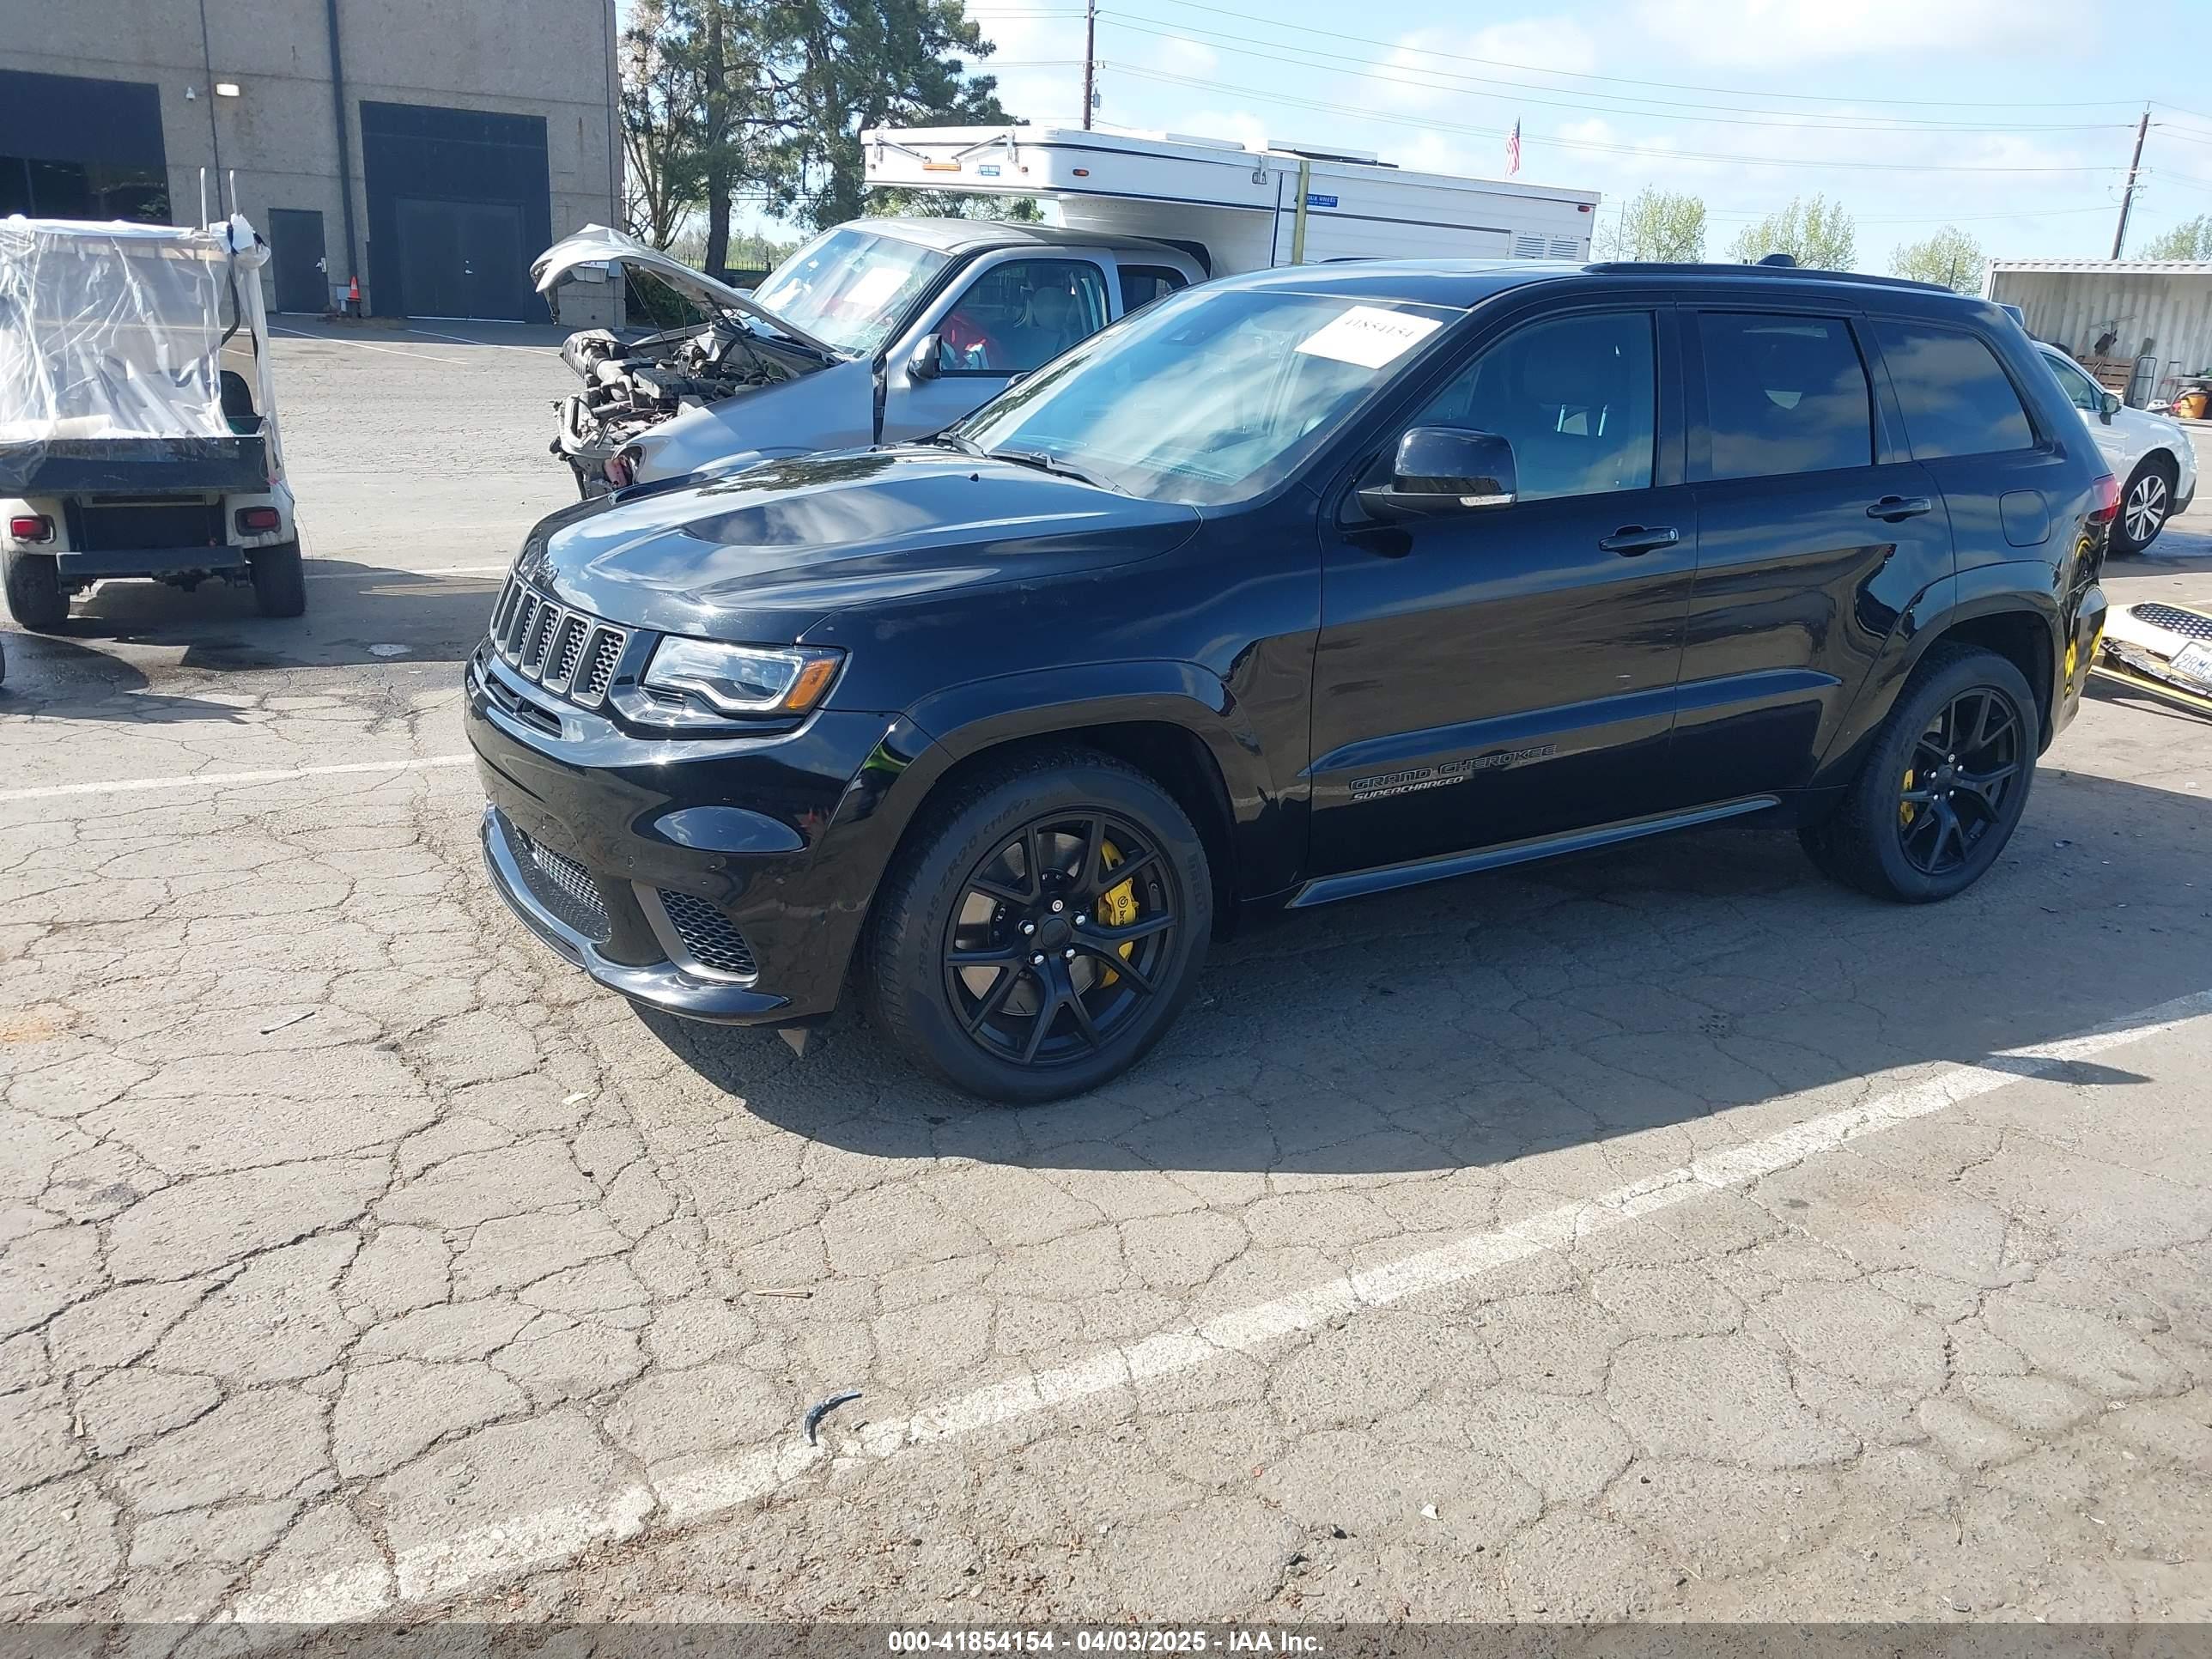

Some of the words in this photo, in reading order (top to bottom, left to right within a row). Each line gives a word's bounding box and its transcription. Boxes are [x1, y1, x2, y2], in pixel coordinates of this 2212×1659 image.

[1350, 768, 1431, 791] GRAND
[1438, 744, 1557, 775] CHEROKEE
[1352, 775, 1464, 802] SUPERCHARGED
